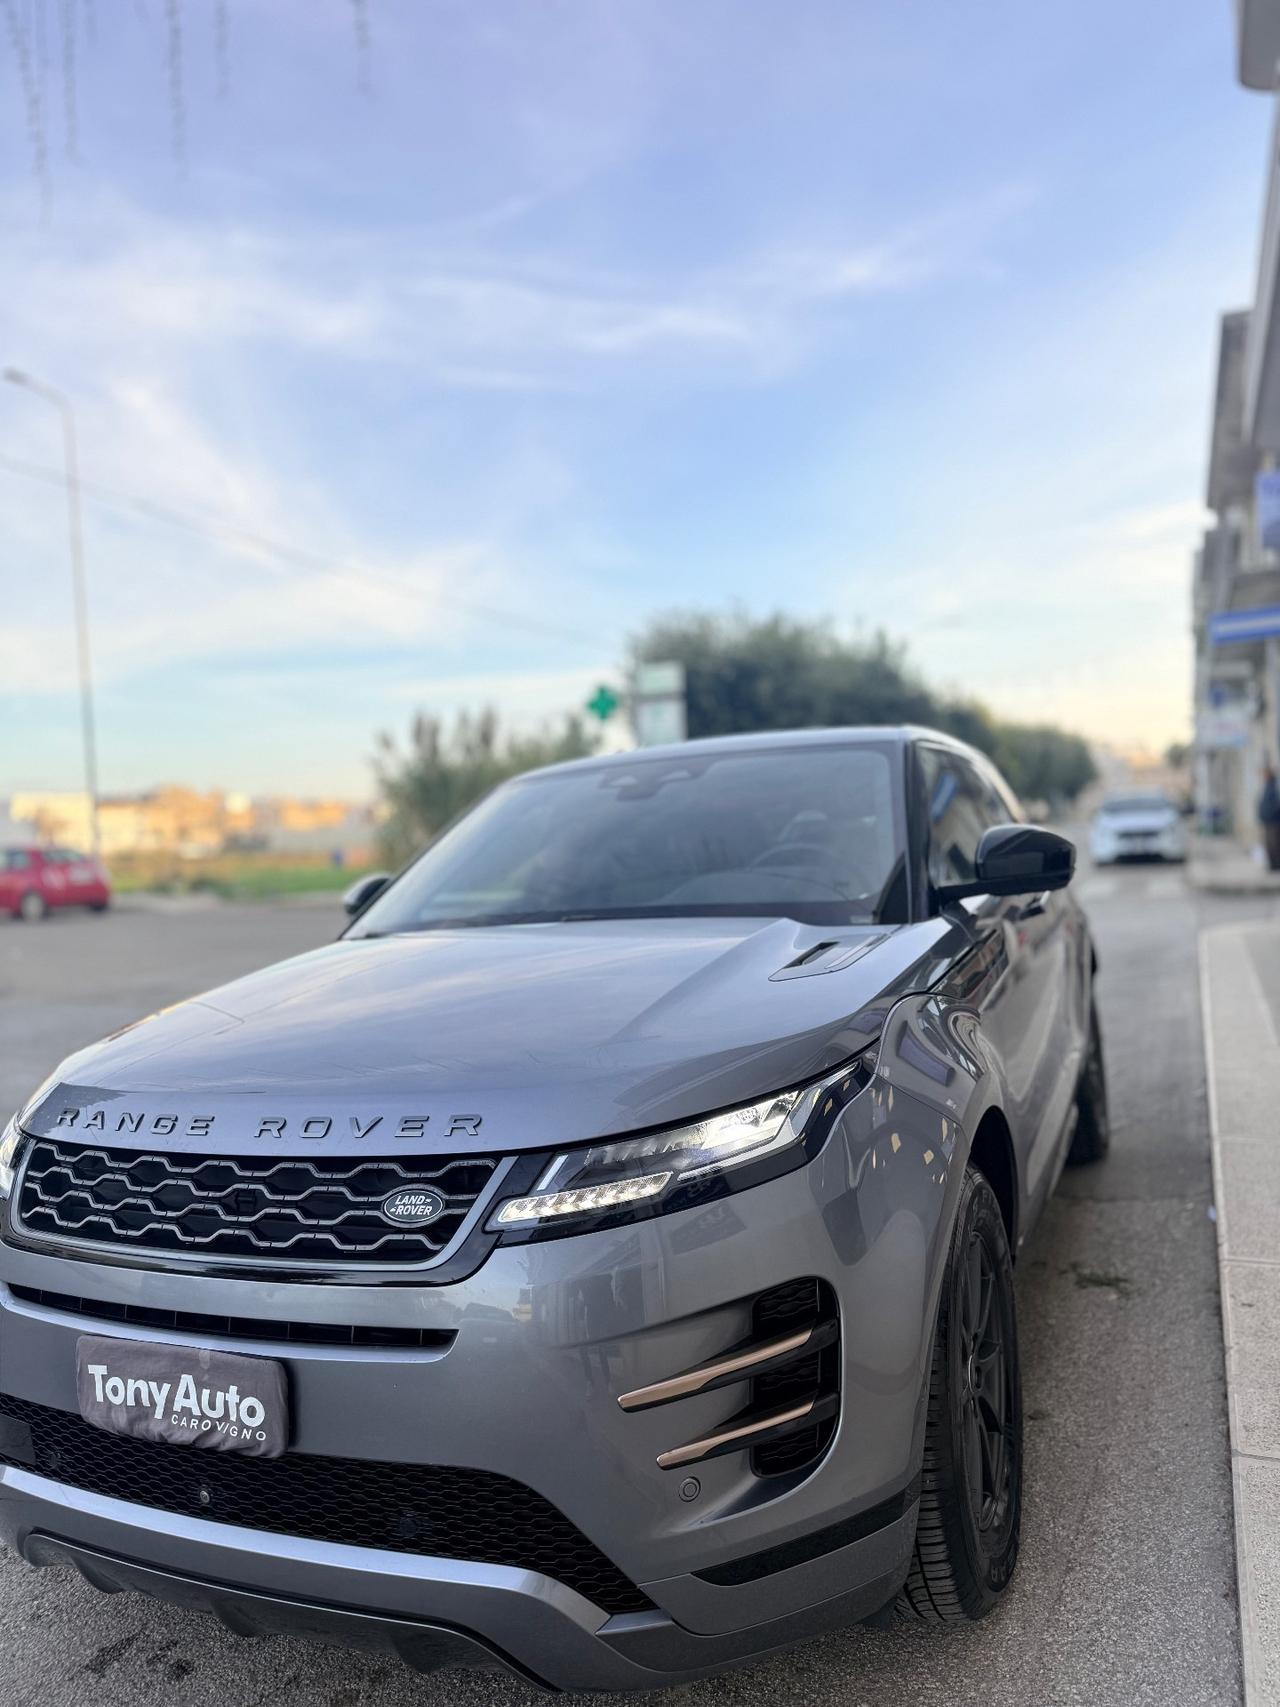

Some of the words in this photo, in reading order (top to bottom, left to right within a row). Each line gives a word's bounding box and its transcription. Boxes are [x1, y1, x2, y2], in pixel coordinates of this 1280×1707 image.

[56, 1107, 216, 1137] RANGE
[253, 1114, 483, 1139] ROVER
[395, 1196, 426, 1205] LAND
[395, 1205, 433, 1215] ROVER
[171, 1415, 267, 1441] CAROVIGNO
